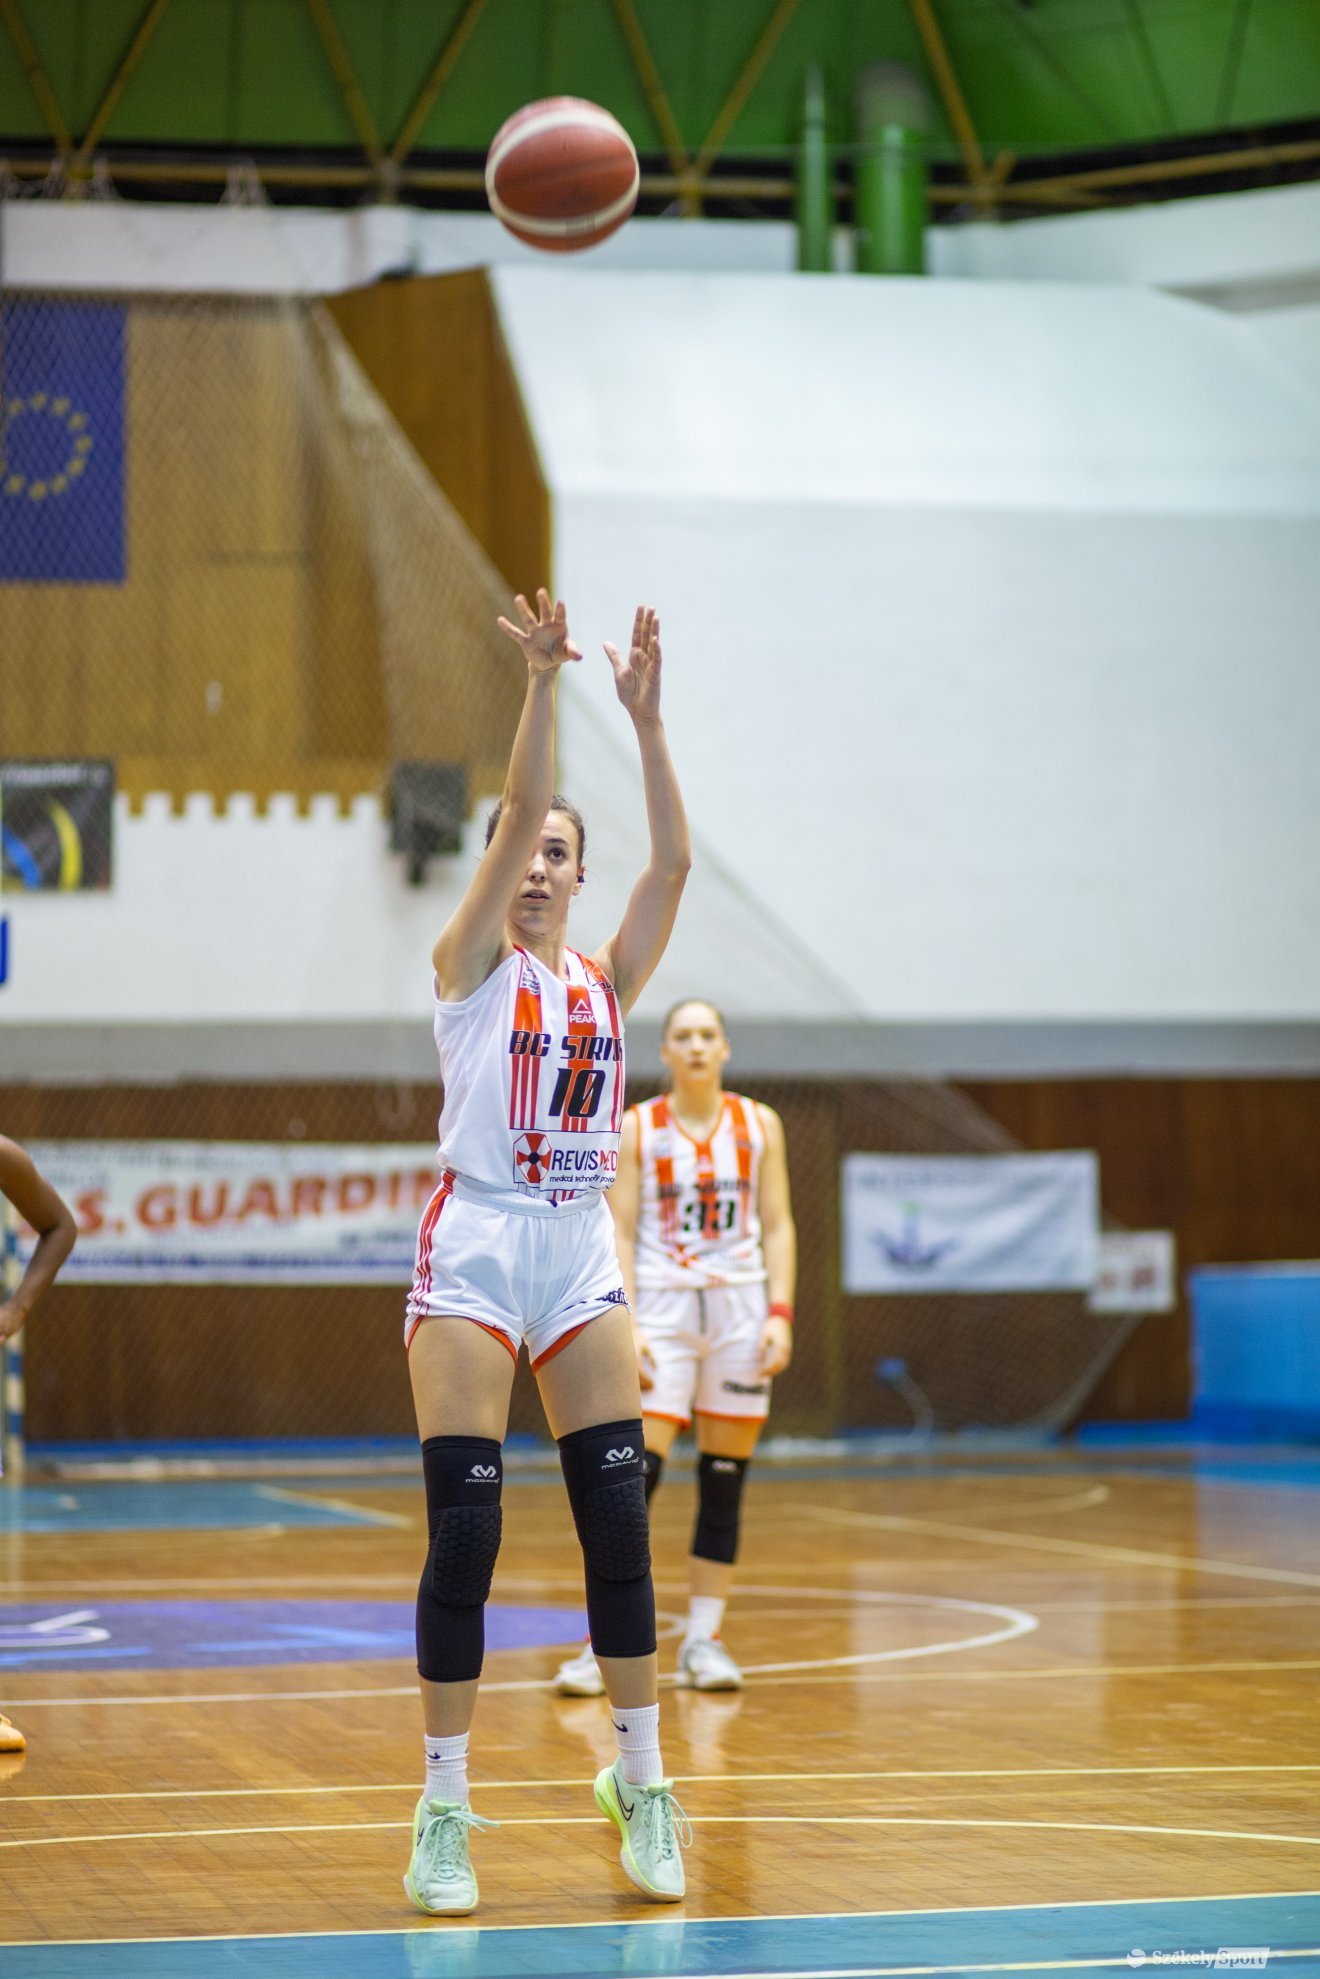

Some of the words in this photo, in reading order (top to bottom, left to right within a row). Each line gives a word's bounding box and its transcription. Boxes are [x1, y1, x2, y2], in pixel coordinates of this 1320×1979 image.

[570, 1014, 596, 1024] PEAK
[509, 1030, 551, 1057] BC
[548, 1067, 606, 1118] 10
[683, 1199, 736, 1232] 33
